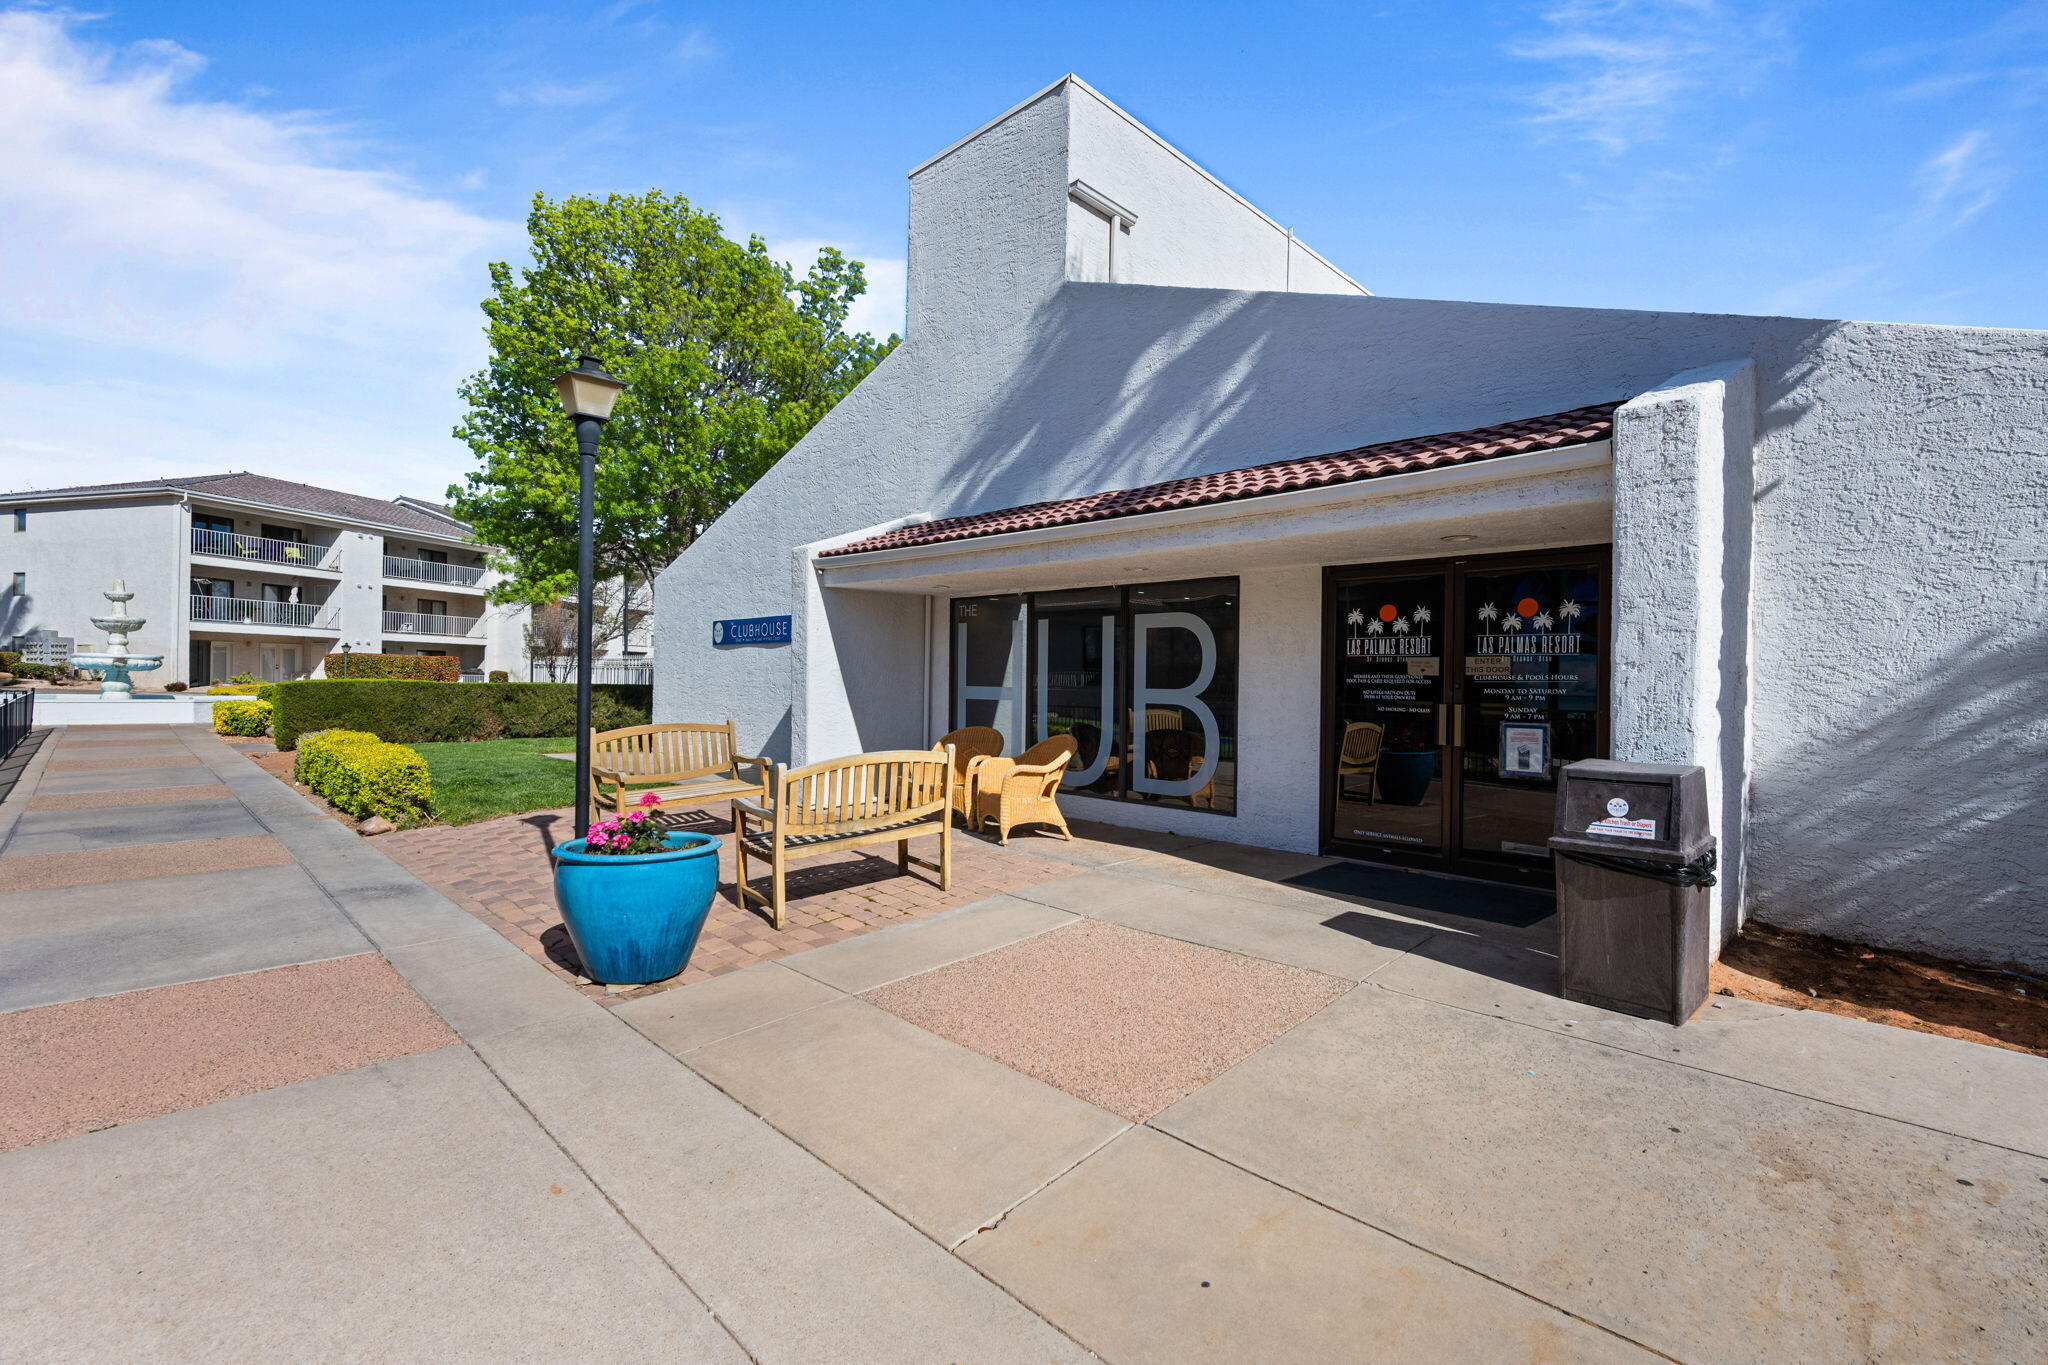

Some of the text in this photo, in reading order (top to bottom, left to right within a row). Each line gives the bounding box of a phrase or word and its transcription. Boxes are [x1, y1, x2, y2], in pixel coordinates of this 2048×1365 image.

[959, 605, 977, 617] THE
[730, 621, 788, 638] CLUBHOUSE
[1347, 637, 1431, 655] LAS PALMAS RESORT
[1477, 635, 1580, 654] LAS PALMAS RESORT
[1529, 687, 1567, 695] SATURDAY
[957, 612, 1220, 797] HUB
